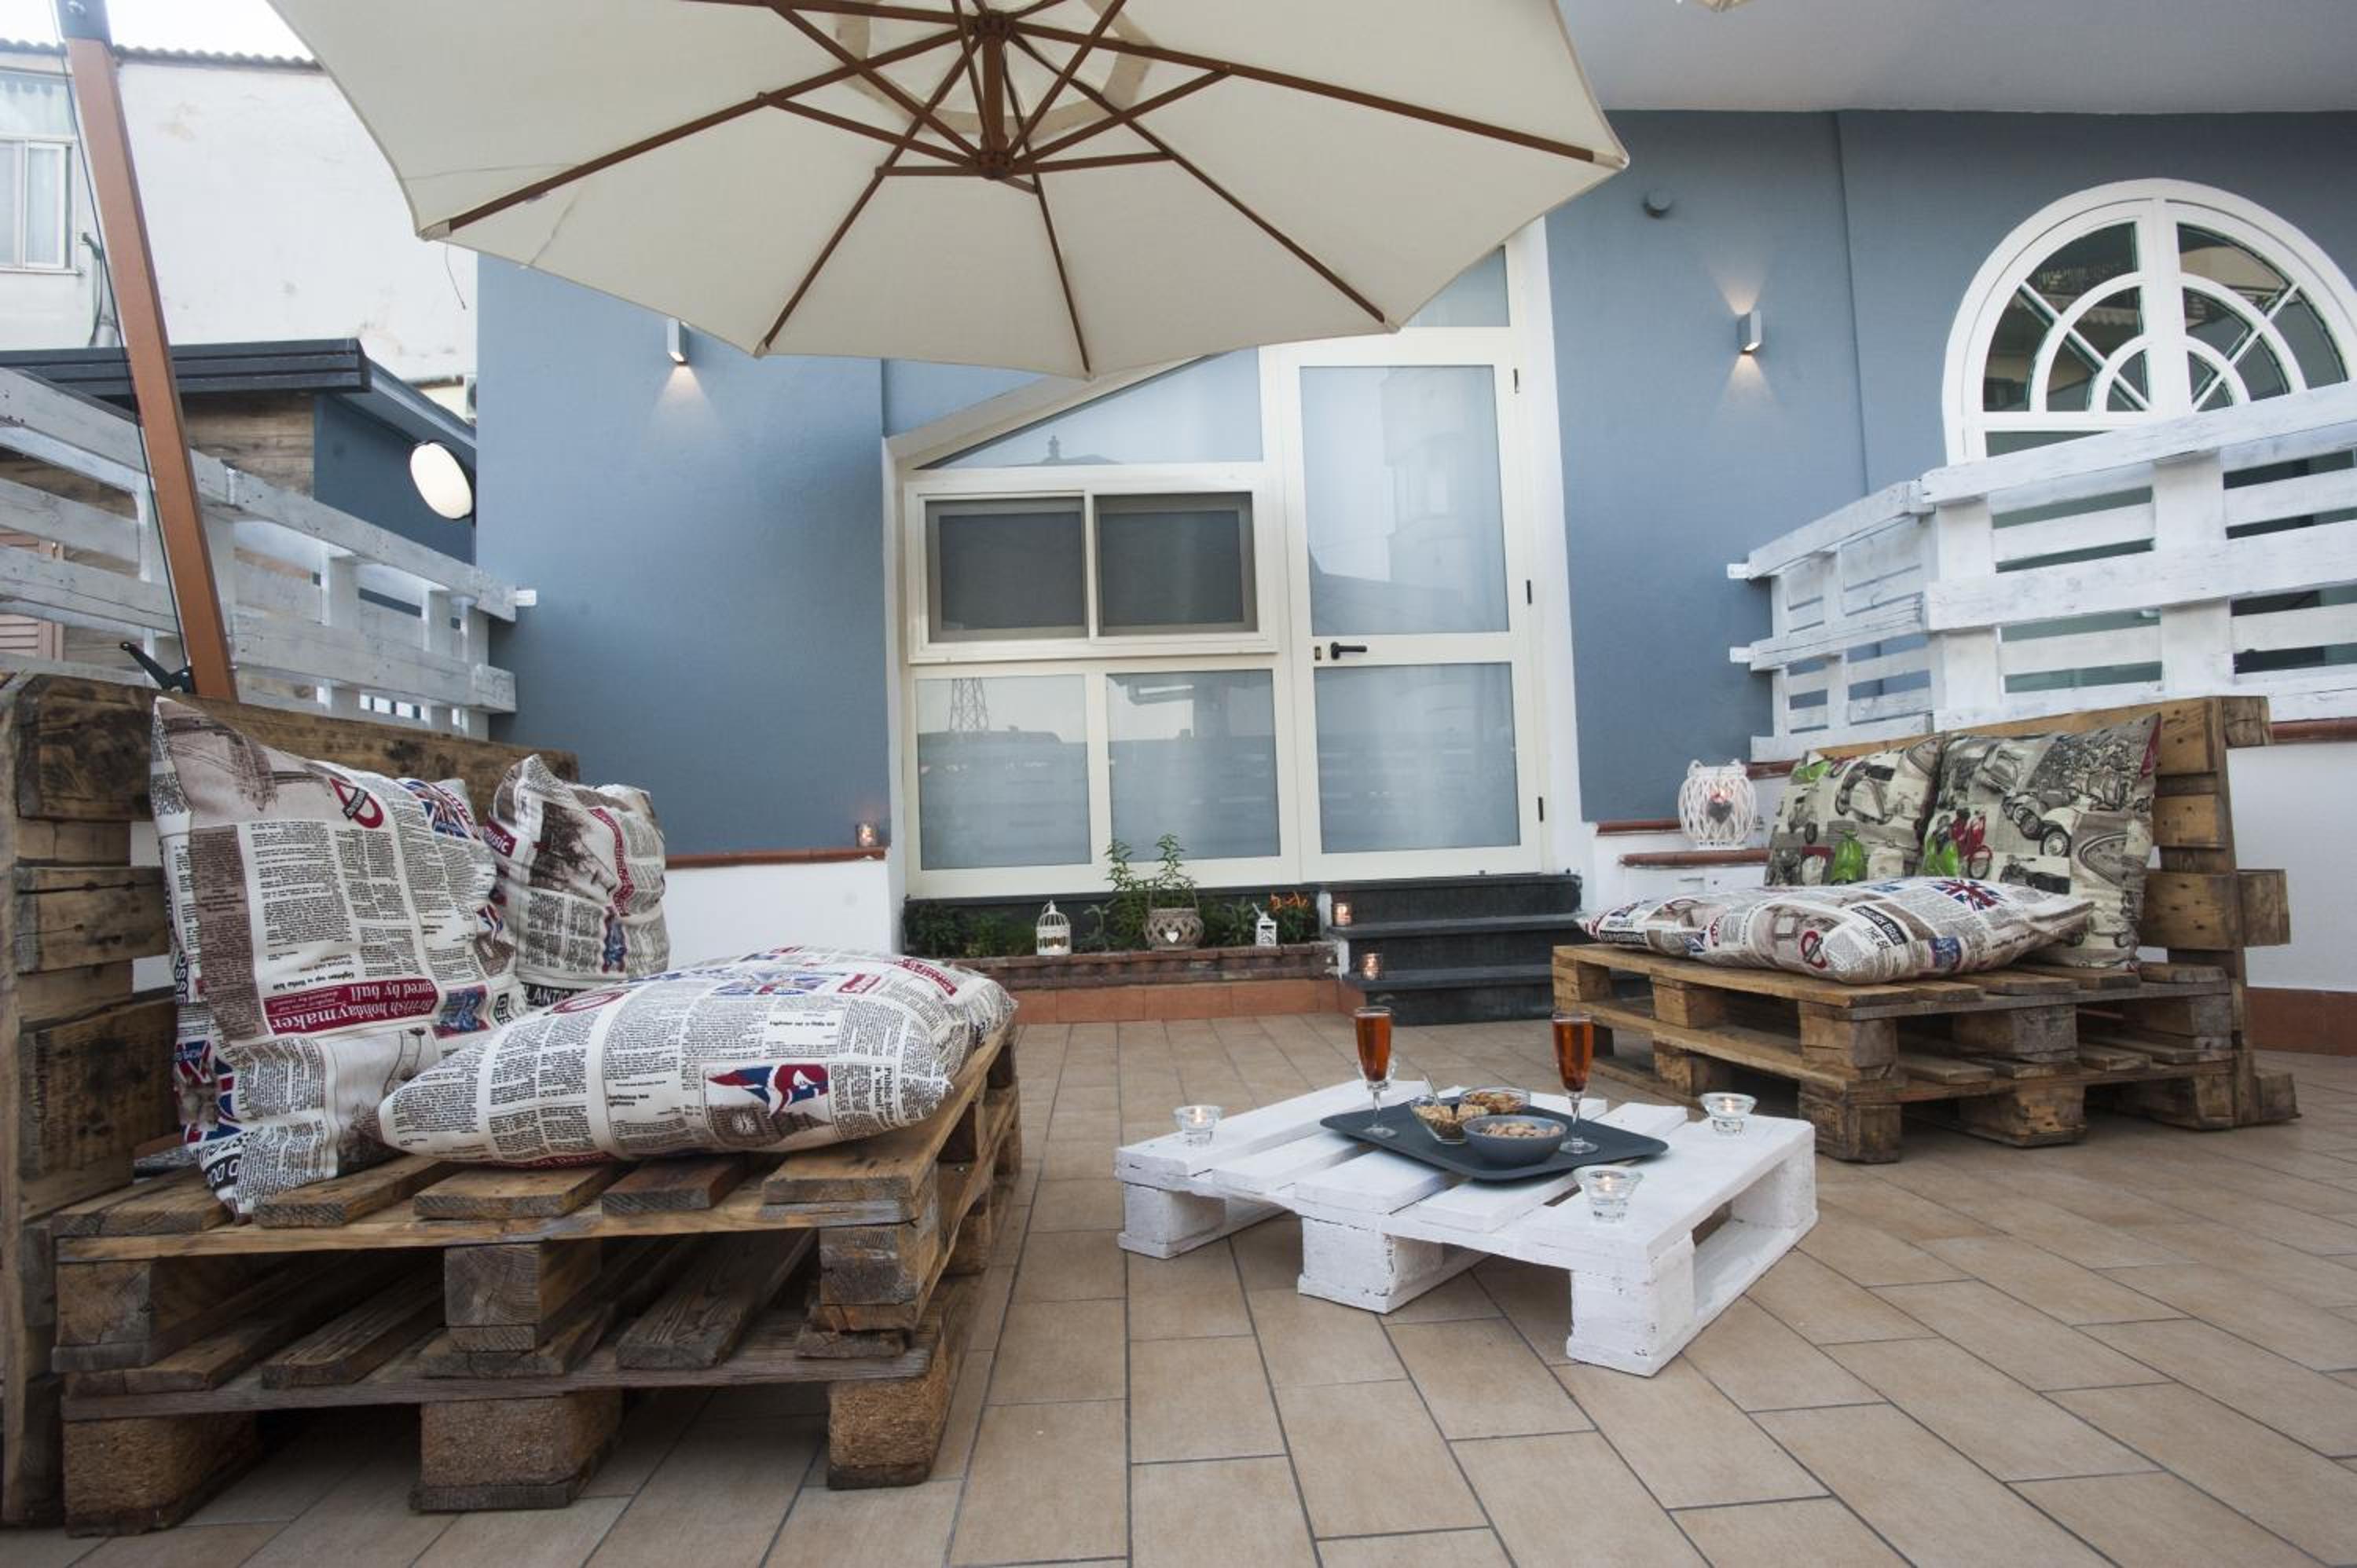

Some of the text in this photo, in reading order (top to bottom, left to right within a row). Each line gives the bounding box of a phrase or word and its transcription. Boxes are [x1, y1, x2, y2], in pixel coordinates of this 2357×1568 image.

[351, 985, 382, 1000] bull
[384, 982, 401, 998] by
[272, 1001, 388, 1030] holidaymaker
